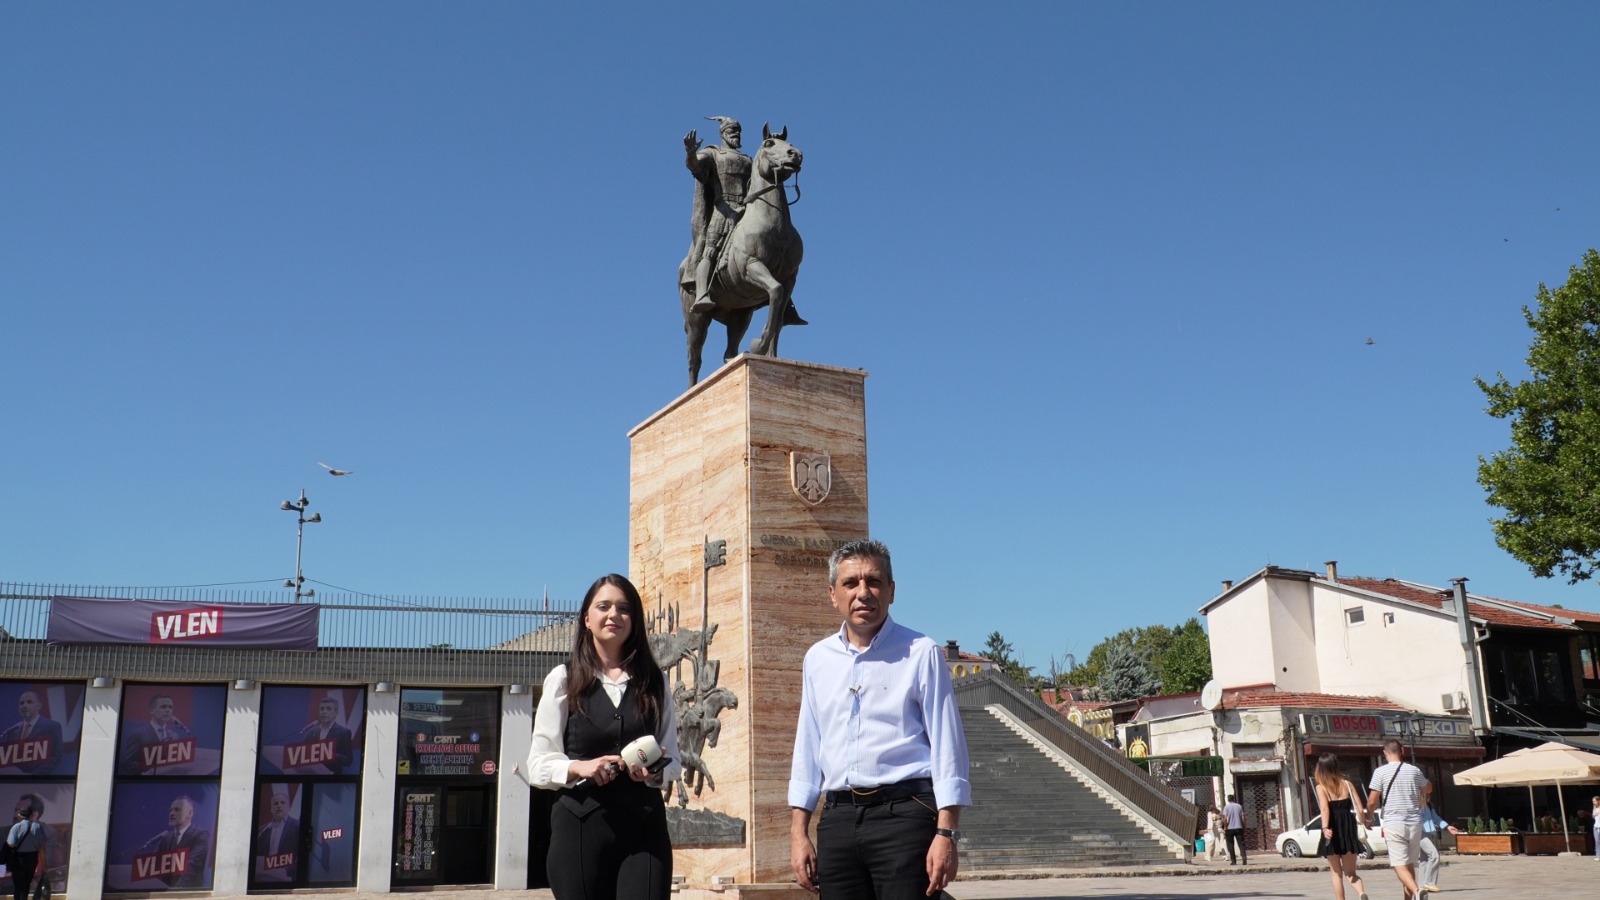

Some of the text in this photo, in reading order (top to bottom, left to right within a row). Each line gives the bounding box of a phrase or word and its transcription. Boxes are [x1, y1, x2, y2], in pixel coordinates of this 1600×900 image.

[156, 610, 218, 640] VLEN
[1332, 715, 1377, 731] BOSCH
[0, 740, 49, 765] VLEN
[143, 741, 192, 766] VLEN
[287, 741, 334, 766] VLEN
[415, 743, 480, 753] EXCHANGE OFFICE
[323, 828, 342, 839] VLEN
[136, 851, 186, 878] VLEN
[266, 853, 293, 869] VLEN
